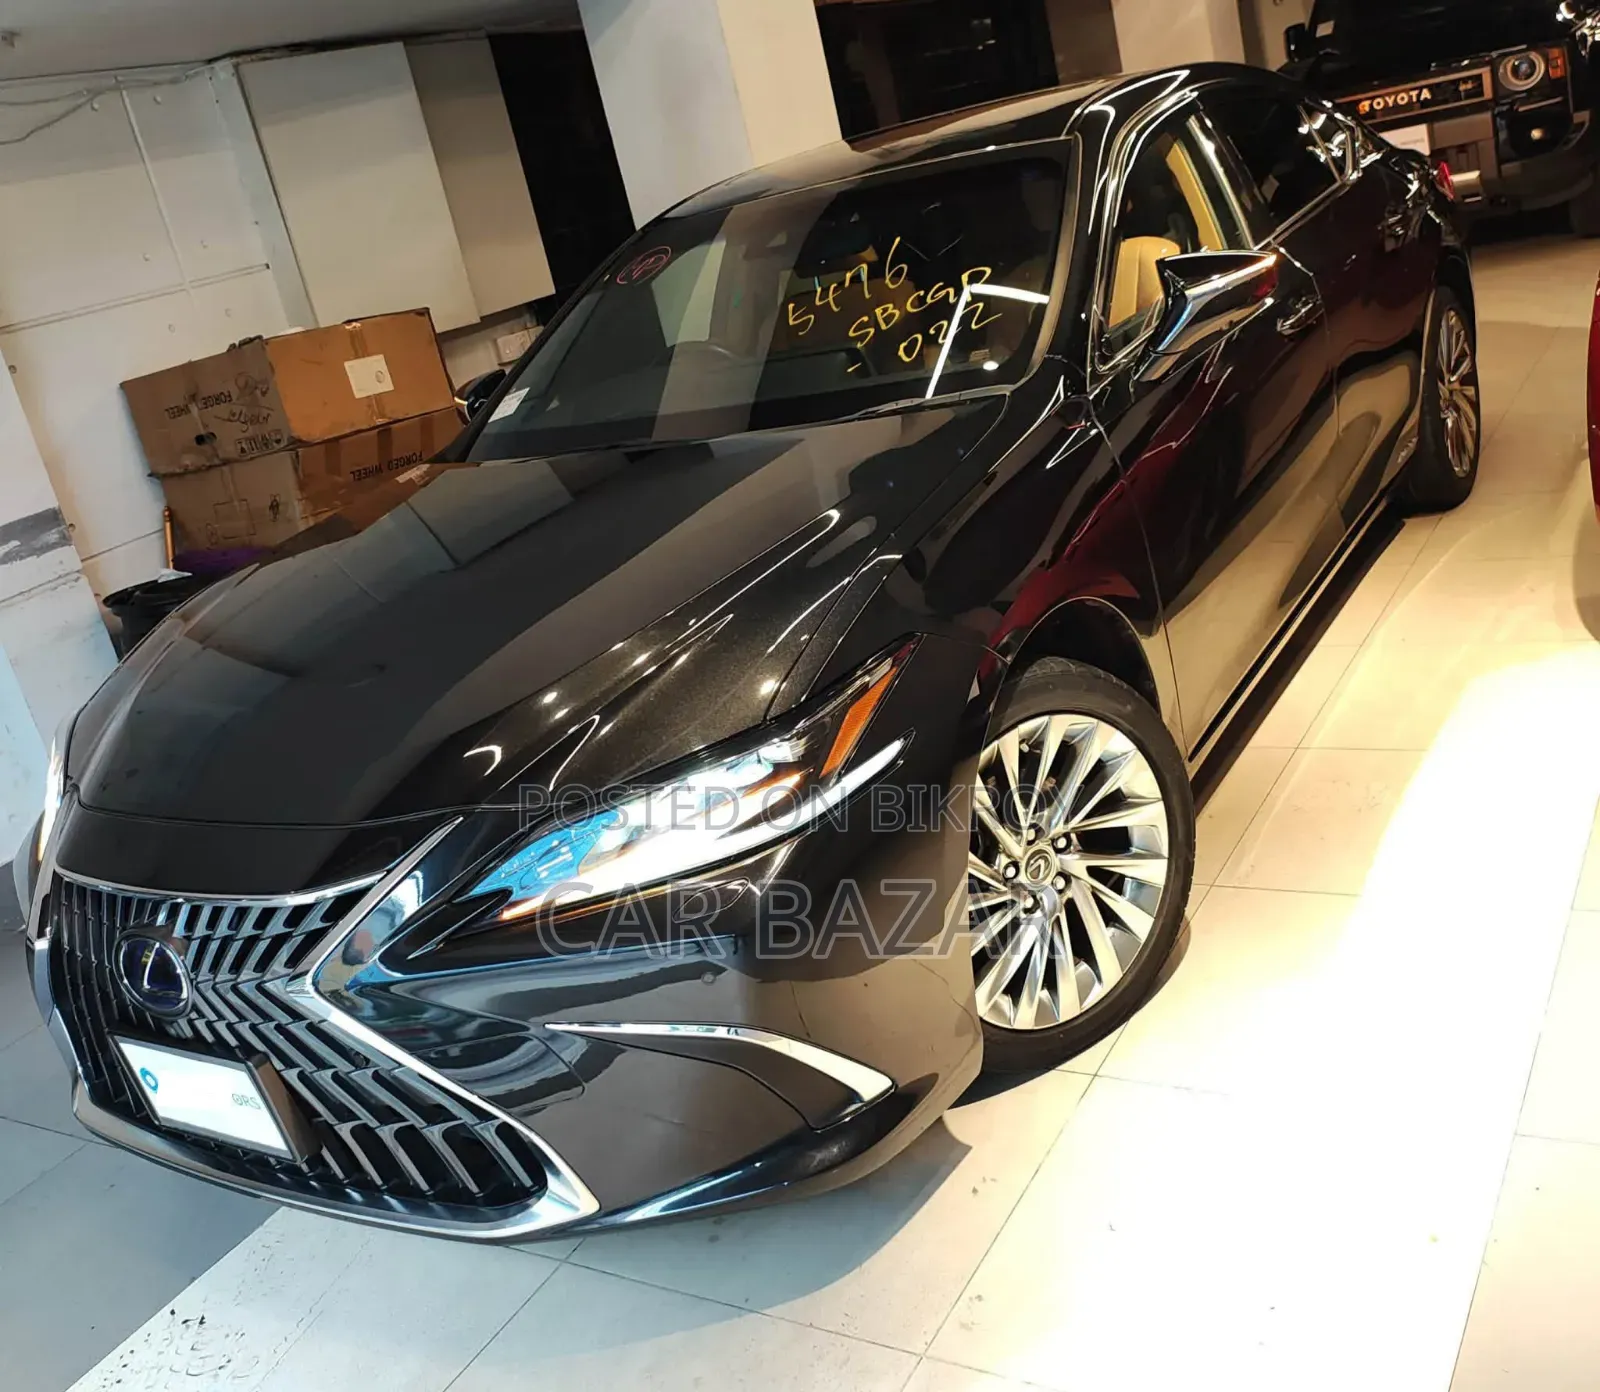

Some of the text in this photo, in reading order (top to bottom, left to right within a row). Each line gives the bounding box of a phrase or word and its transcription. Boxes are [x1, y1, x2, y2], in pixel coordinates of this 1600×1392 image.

[1358, 88, 1432, 114] TOYOTA
[349, 450, 424, 481] FORGED WHEEL
